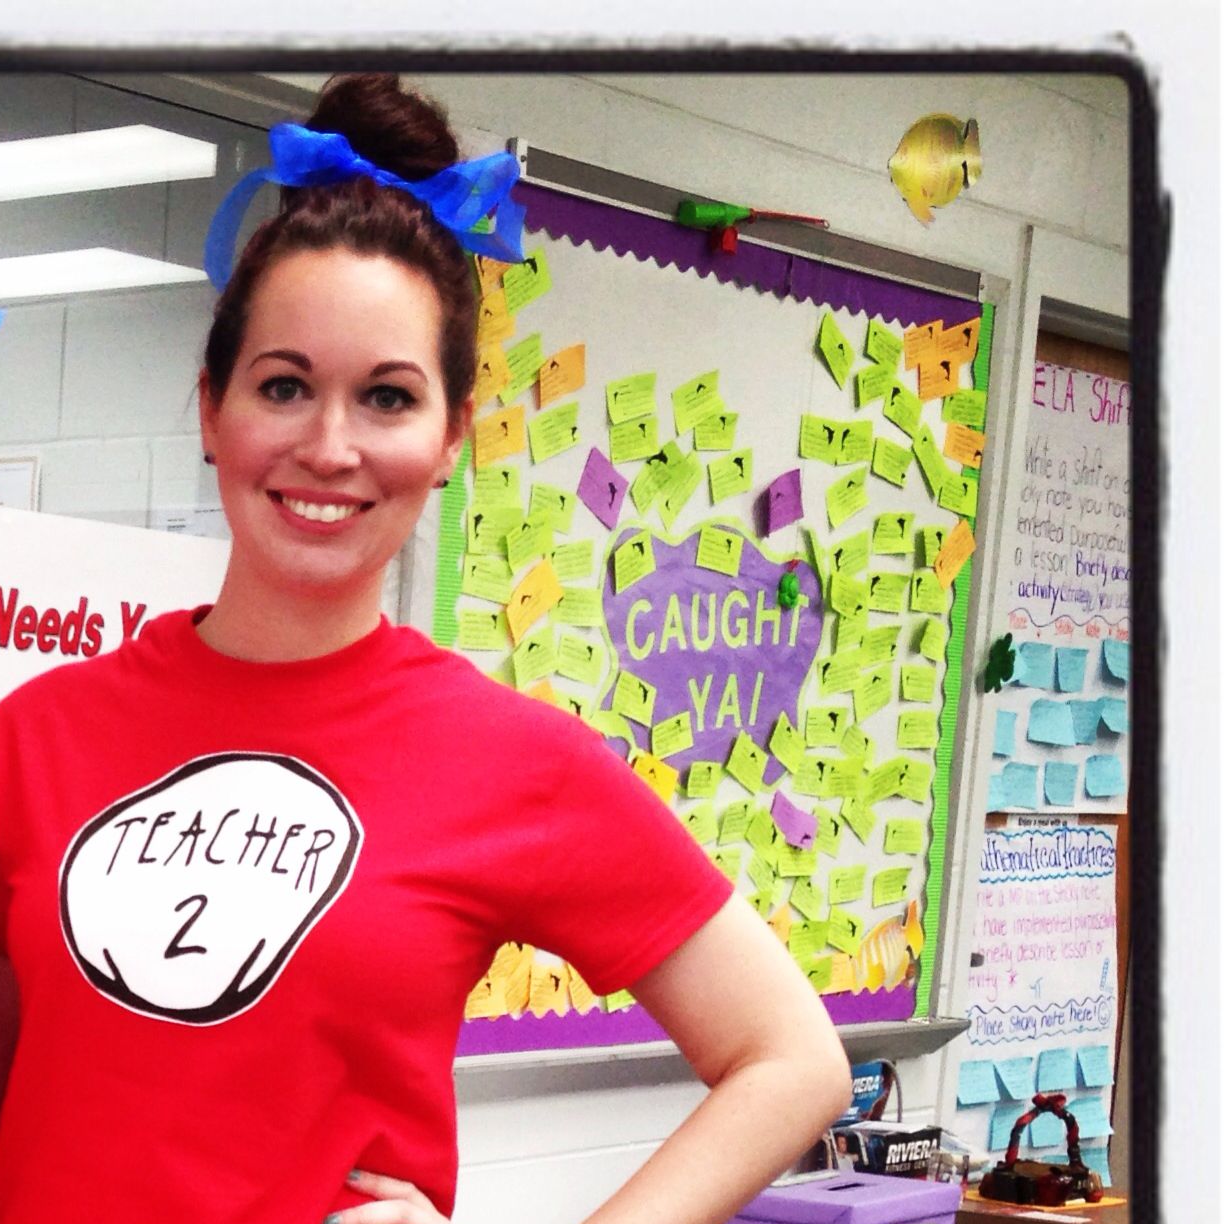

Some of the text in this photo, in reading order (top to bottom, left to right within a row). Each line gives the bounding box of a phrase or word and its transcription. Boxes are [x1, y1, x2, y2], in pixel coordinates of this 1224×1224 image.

[1033, 367, 1075, 412] ELA
[121, 601, 150, 641] Y
[626, 589, 810, 661] CAUGHT
[107, 810, 336, 894] TEACHER
[164, 894, 208, 959] 2
[886, 1139, 938, 1164] RIVIERA
